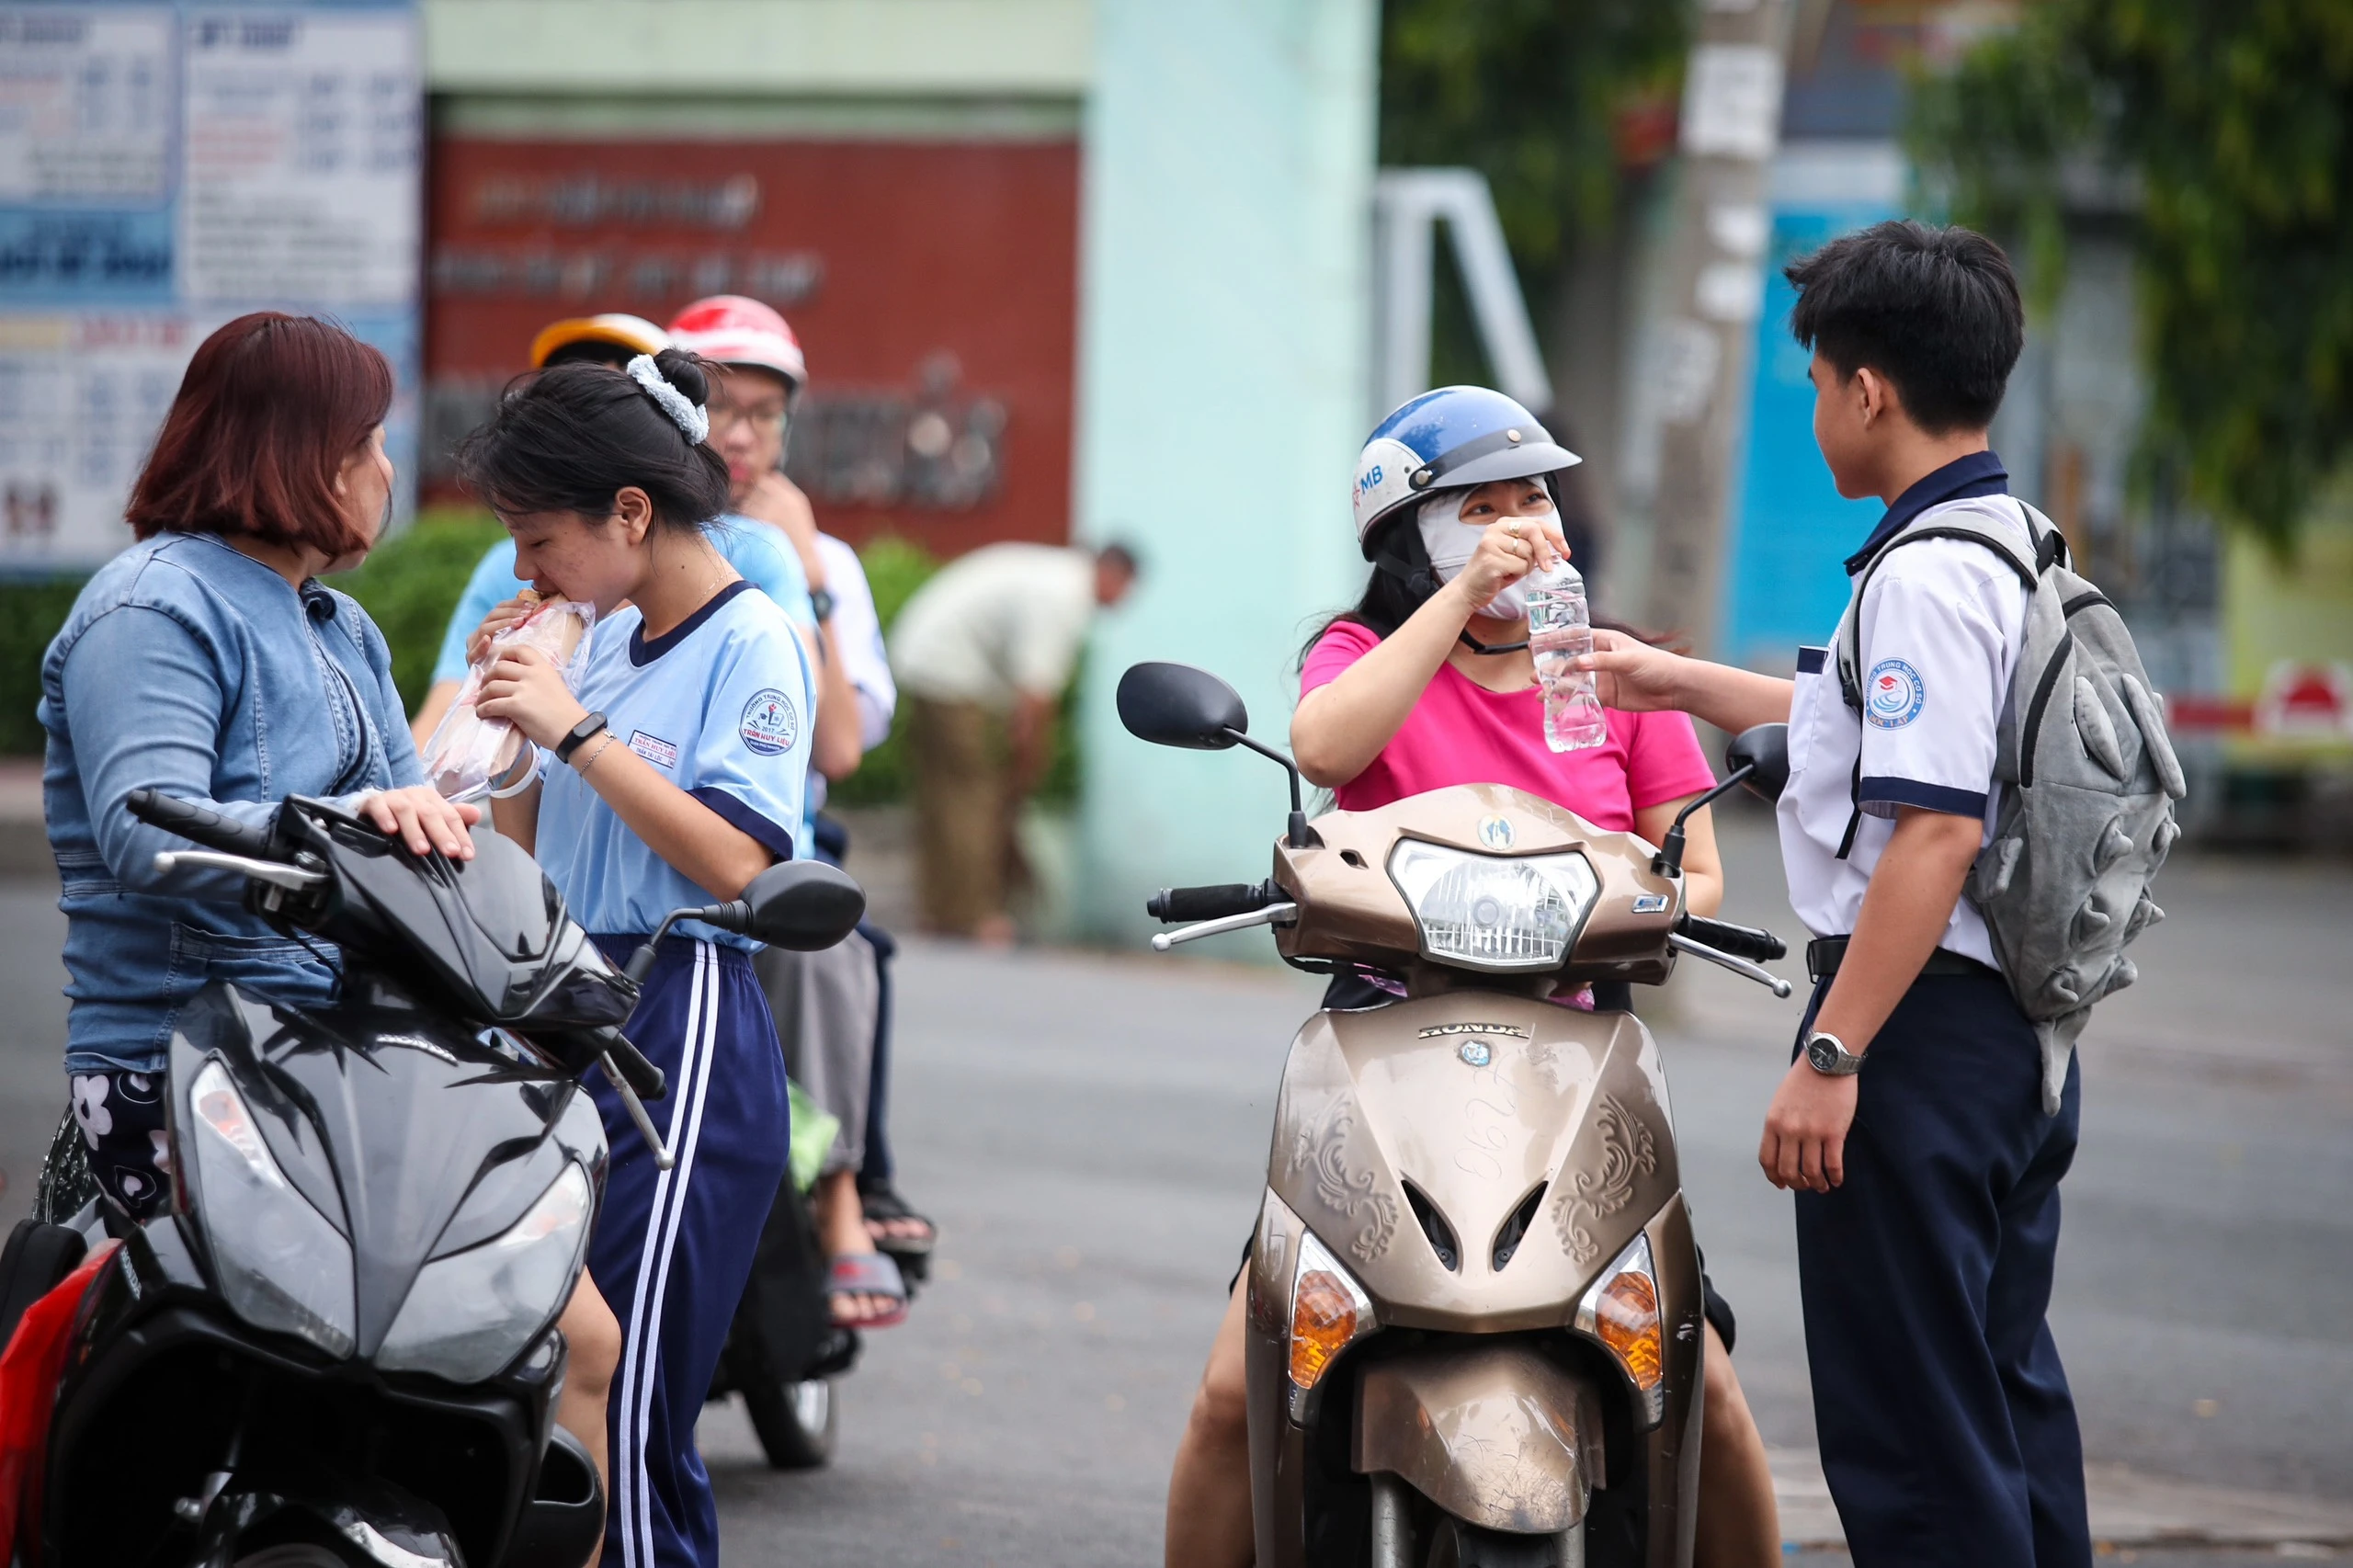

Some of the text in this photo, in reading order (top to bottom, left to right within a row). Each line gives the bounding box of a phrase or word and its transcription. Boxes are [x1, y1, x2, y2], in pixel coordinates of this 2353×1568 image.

[1877, 661, 1901, 672] TRUNG
[761, 725, 775, 733] 2017
[761, 733, 776, 742] HUY
[1418, 1022, 1529, 1040] HONDA
